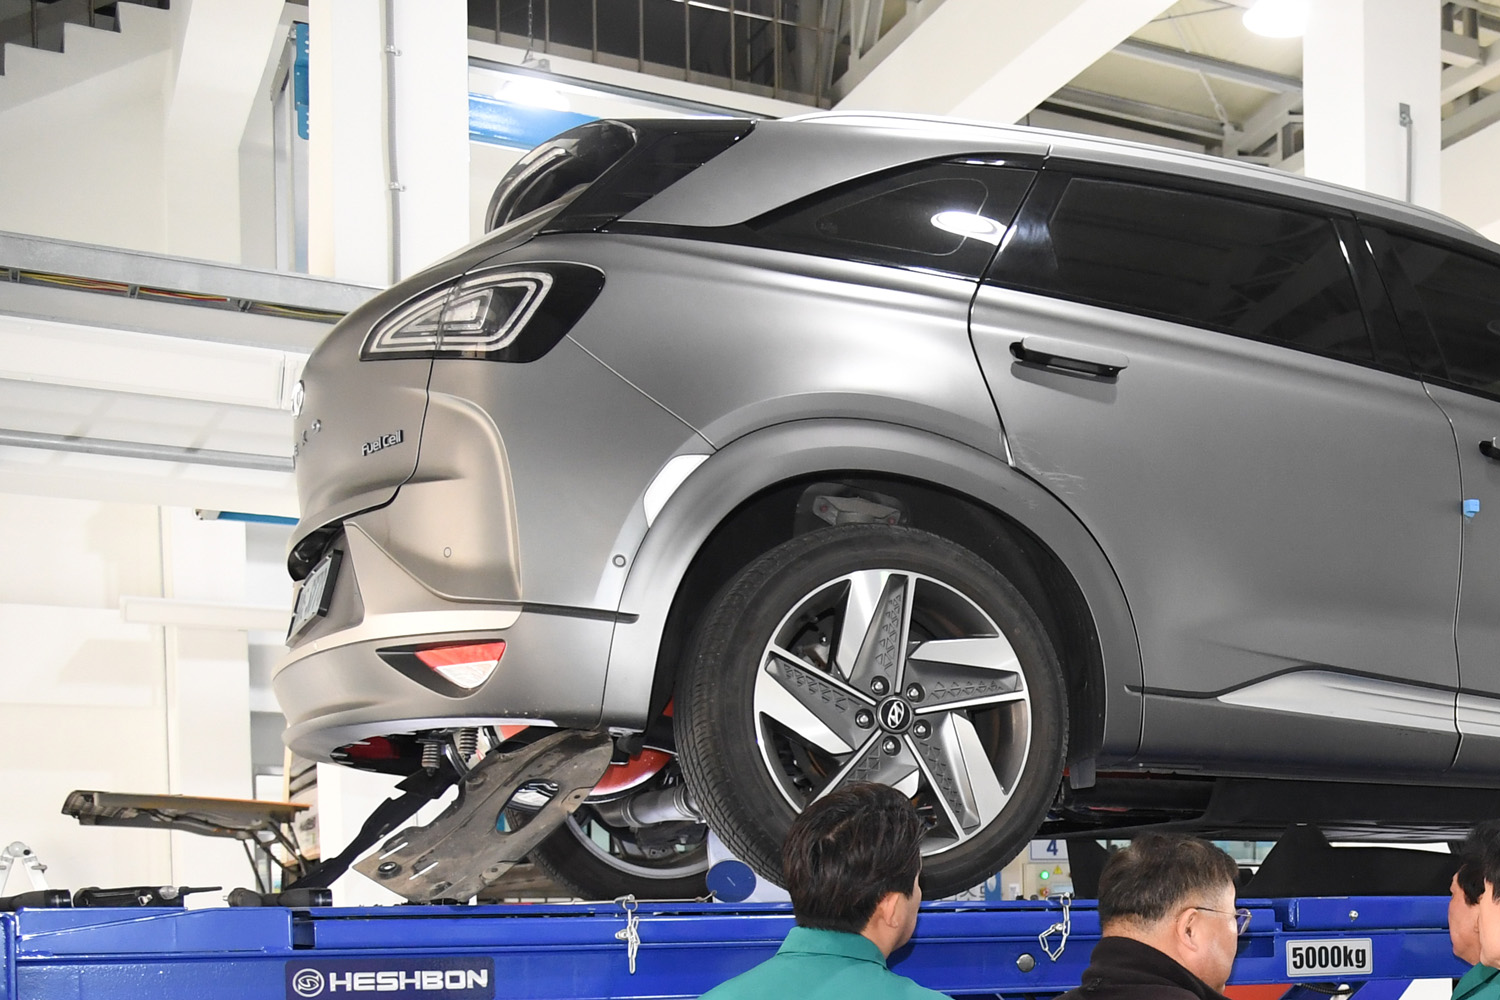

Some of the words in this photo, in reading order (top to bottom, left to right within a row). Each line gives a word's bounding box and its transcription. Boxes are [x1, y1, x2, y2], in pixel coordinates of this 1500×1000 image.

[361, 436, 383, 456] Fuel
[382, 430, 404, 448] Cell
[1046, 839, 1058, 856] 4
[1292, 945, 1367, 970] 5000kg
[329, 969, 488, 992] HESHBON
